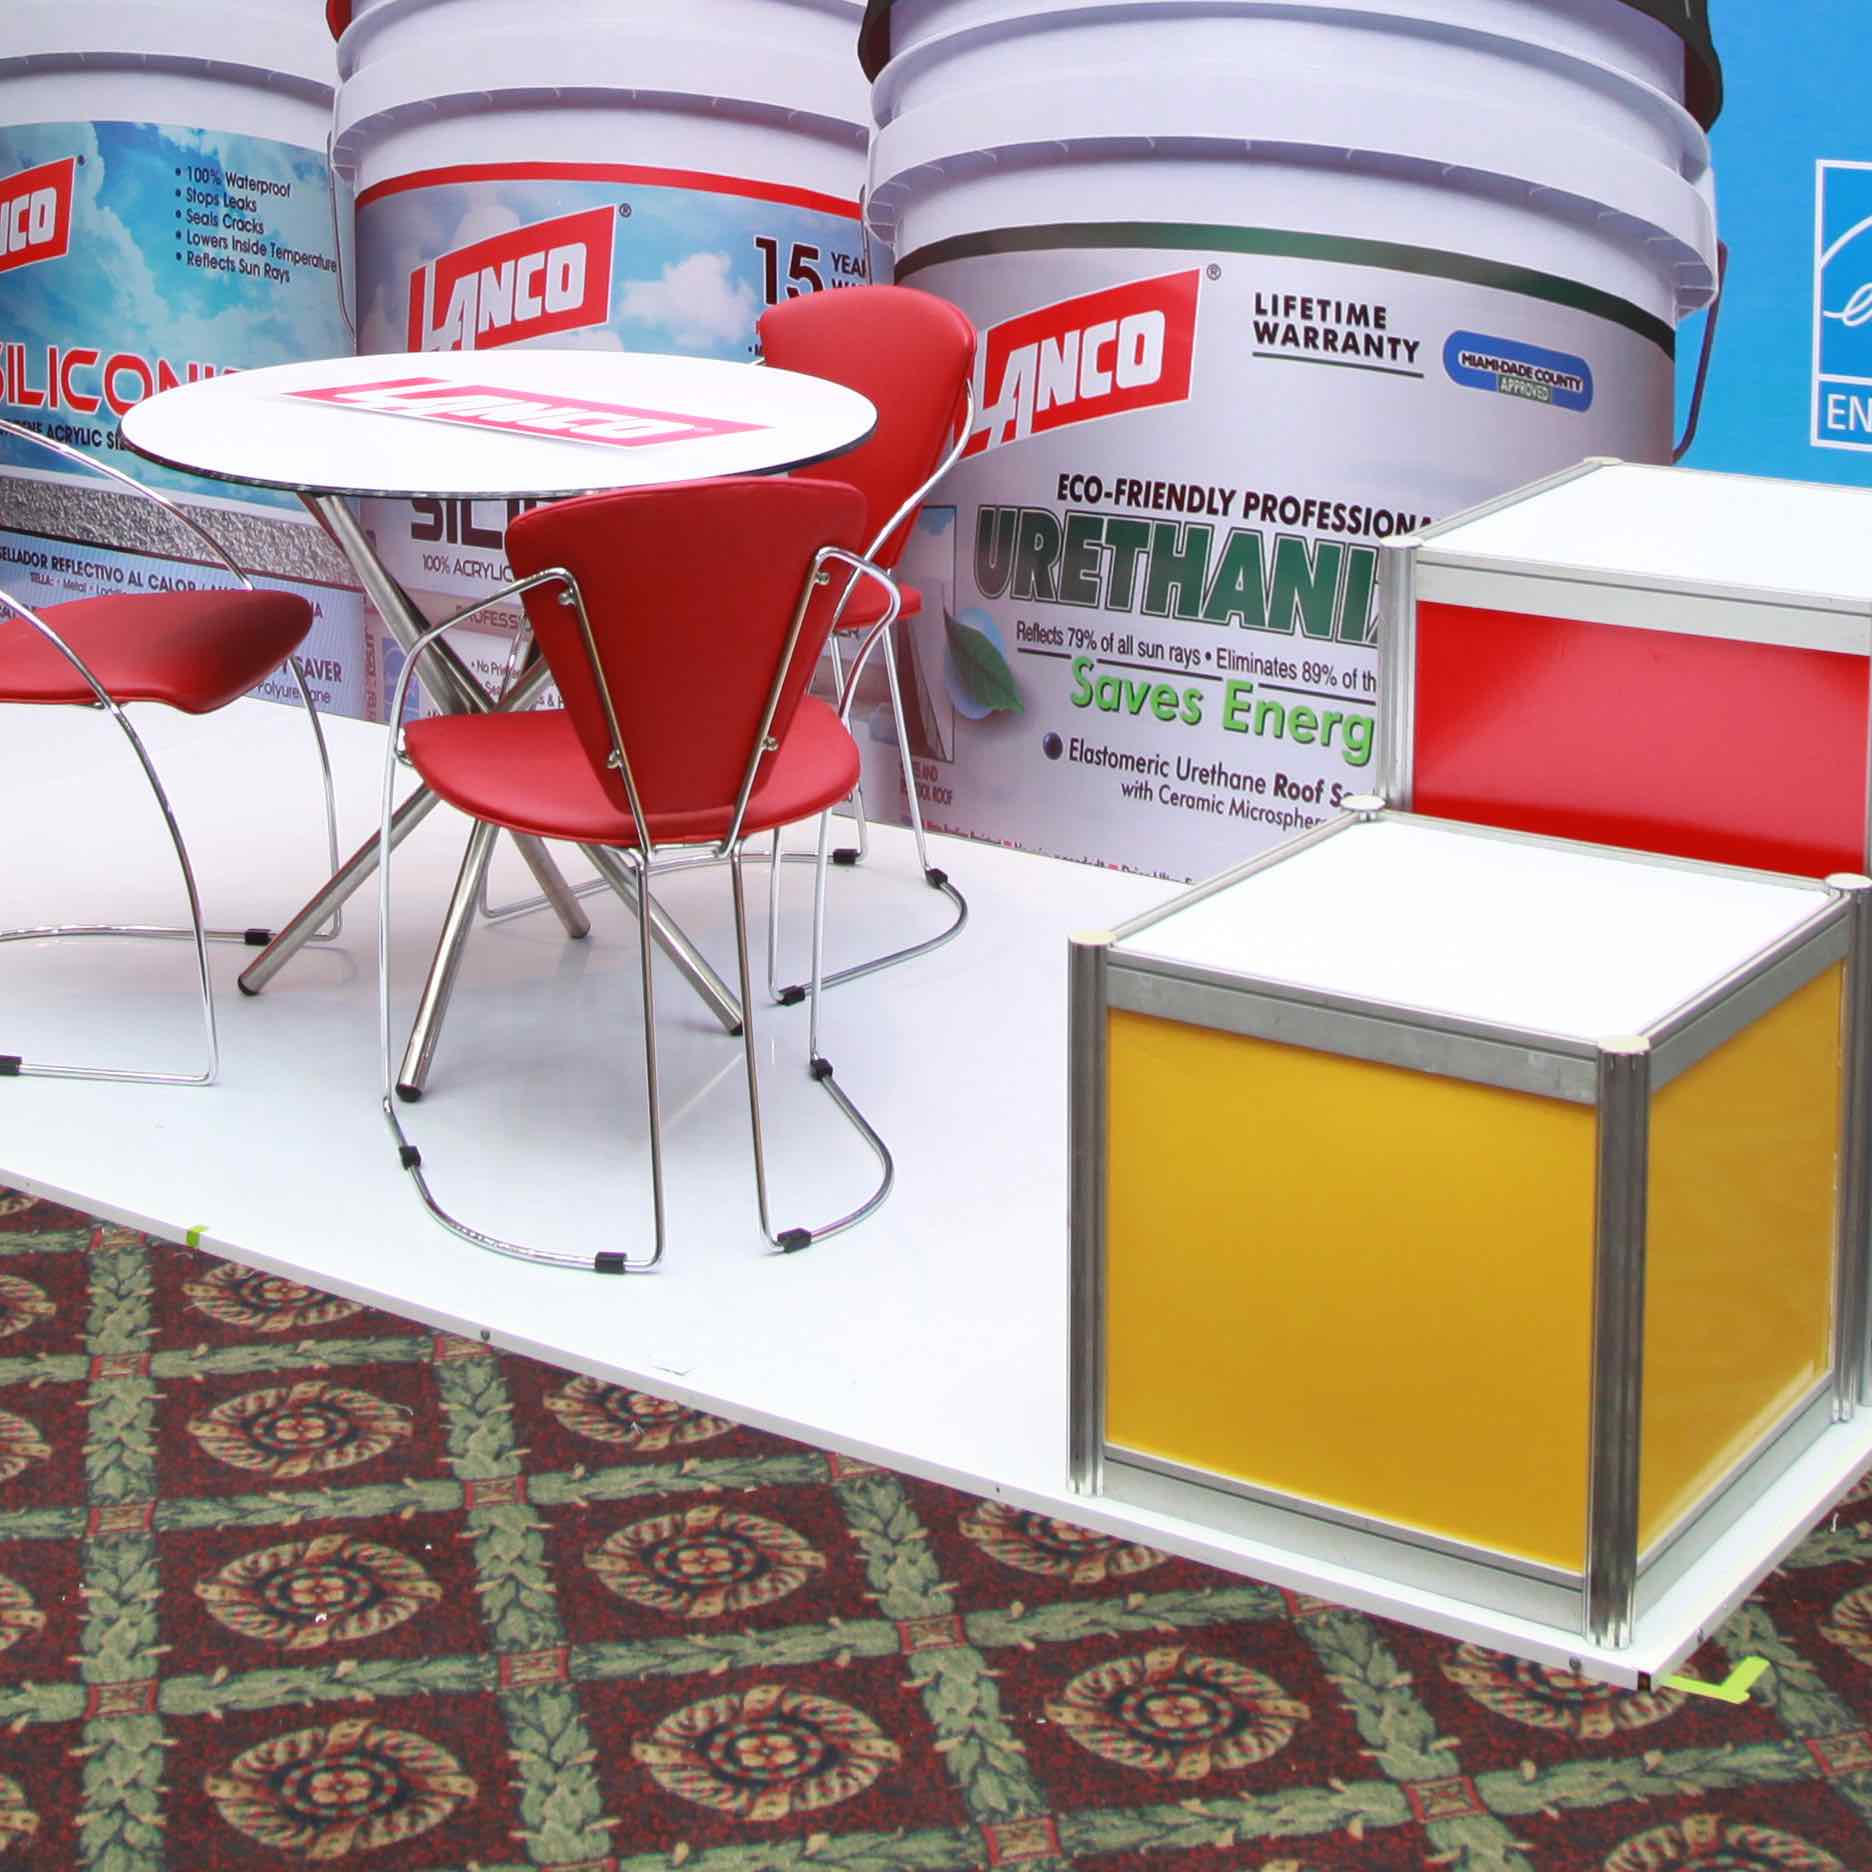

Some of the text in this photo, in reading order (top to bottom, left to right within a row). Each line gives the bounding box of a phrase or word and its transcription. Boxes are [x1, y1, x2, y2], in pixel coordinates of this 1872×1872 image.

[186, 165, 291, 198] 100% Waterproof
[186, 187, 257, 213] Stops Leaks
[186, 208, 264, 235] Seals Cracks
[187, 230, 337, 273] Lowers Inside Temperature
[187, 251, 291, 285] Reflects Sun Rays
[753, 235, 825, 306] 15
[421, 242, 588, 352] LANCO
[1254, 292, 1387, 329] LIFETIME
[1253, 320, 1421, 364] WARRANTY
[971, 309, 1165, 449] LANCO
[1500, 376, 1550, 402] APPROVED
[1534, 368, 1584, 393] COUNTY
[1057, 473, 1237, 517] ECO-FRIENDLY
[52, 557, 124, 583] REFLECTIVO
[129, 570, 144, 588] AL
[422, 553, 515, 583] 100% ACRYLIC
[1017, 620, 1064, 646] Reflects
[1067, 627, 1097, 652] 79%
[1101, 631, 1115, 653] of
[1118, 633, 1135, 655] all
[1138, 640, 1164, 659] sun
[1169, 645, 1201, 670] rays
[1216, 648, 1297, 680] Eliminates
[1301, 661, 1337, 687] 89%
[1342, 667, 1358, 689] of
[1070, 655, 1204, 727] Saves
[1069, 737, 1170, 779] Elastomeric
[1176, 756, 1266, 795] Urethane
[1273, 773, 1325, 803] Roof
[1121, 780, 1154, 802] with
[1159, 784, 1224, 815] Ceramic
